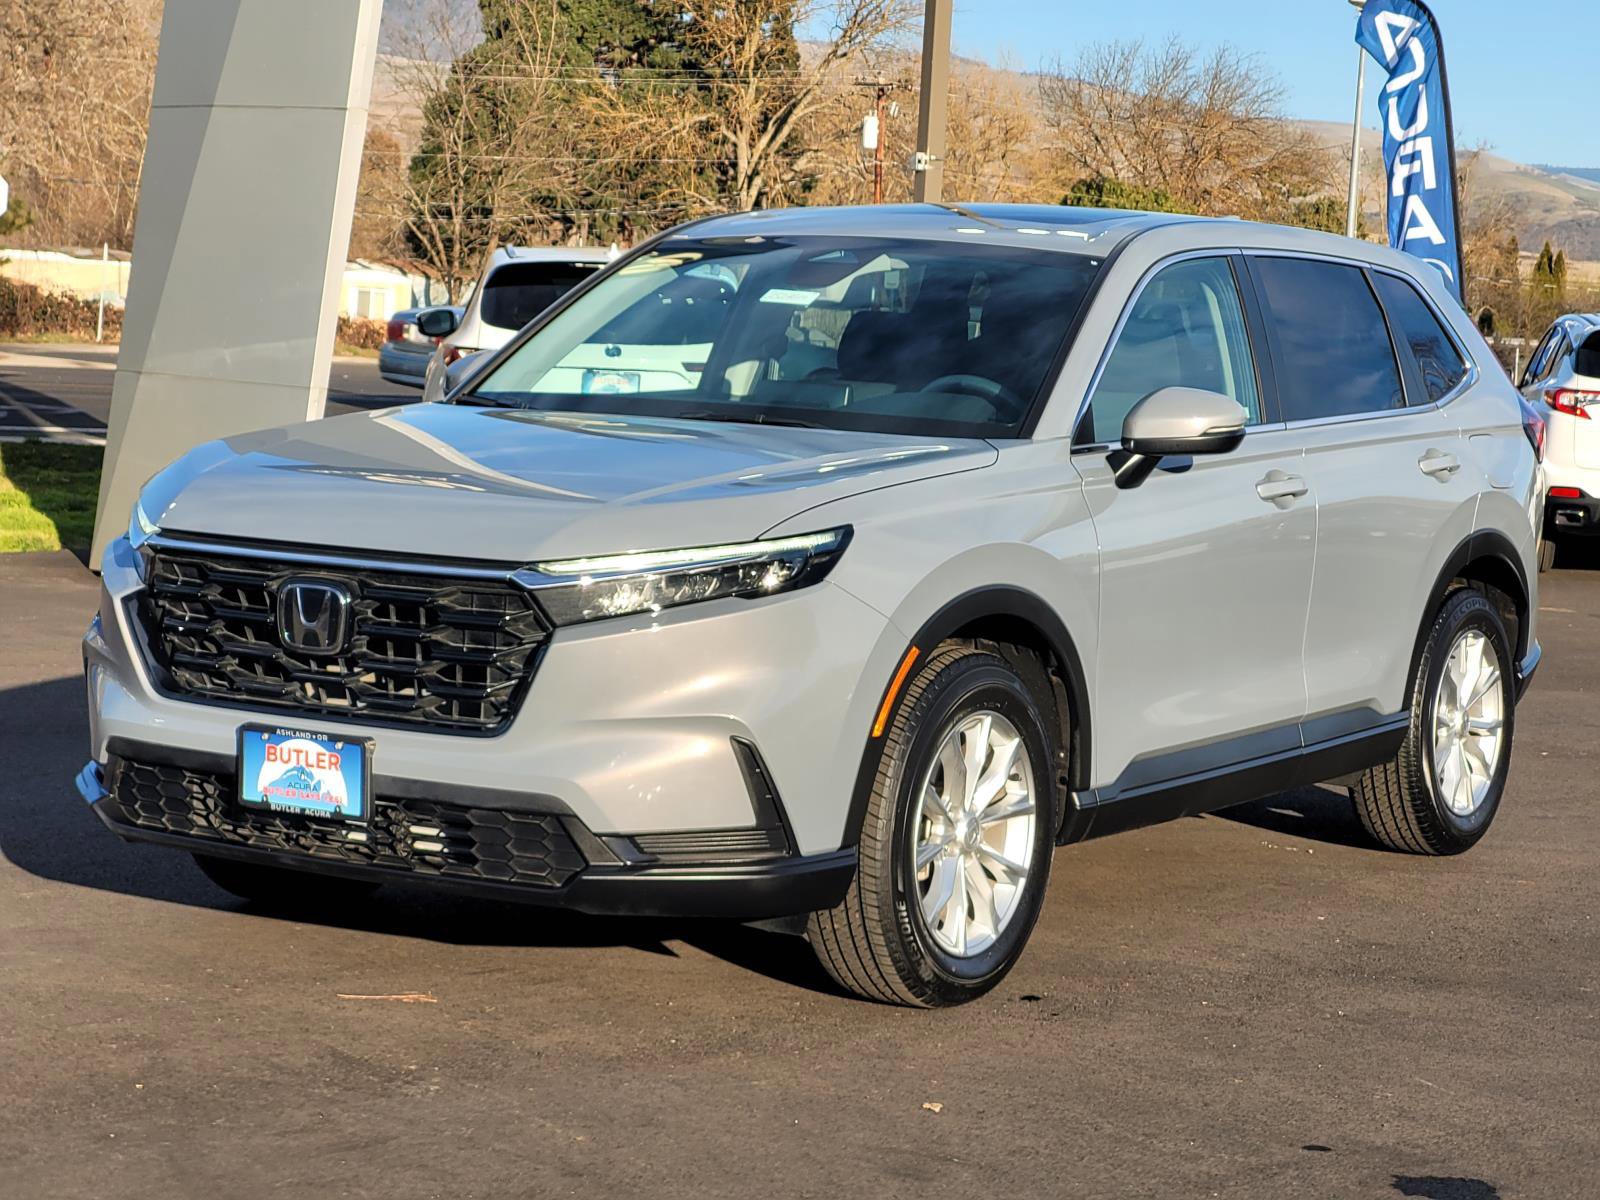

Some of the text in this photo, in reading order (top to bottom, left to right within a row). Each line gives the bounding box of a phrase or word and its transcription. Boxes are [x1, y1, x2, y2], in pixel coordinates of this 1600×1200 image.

[276, 728, 328, 741] ASHLAND OR
[265, 743, 341, 771] BUTLER
[287, 781, 318, 792] ACURA
[271, 803, 331, 818] BUTLER ACURA
